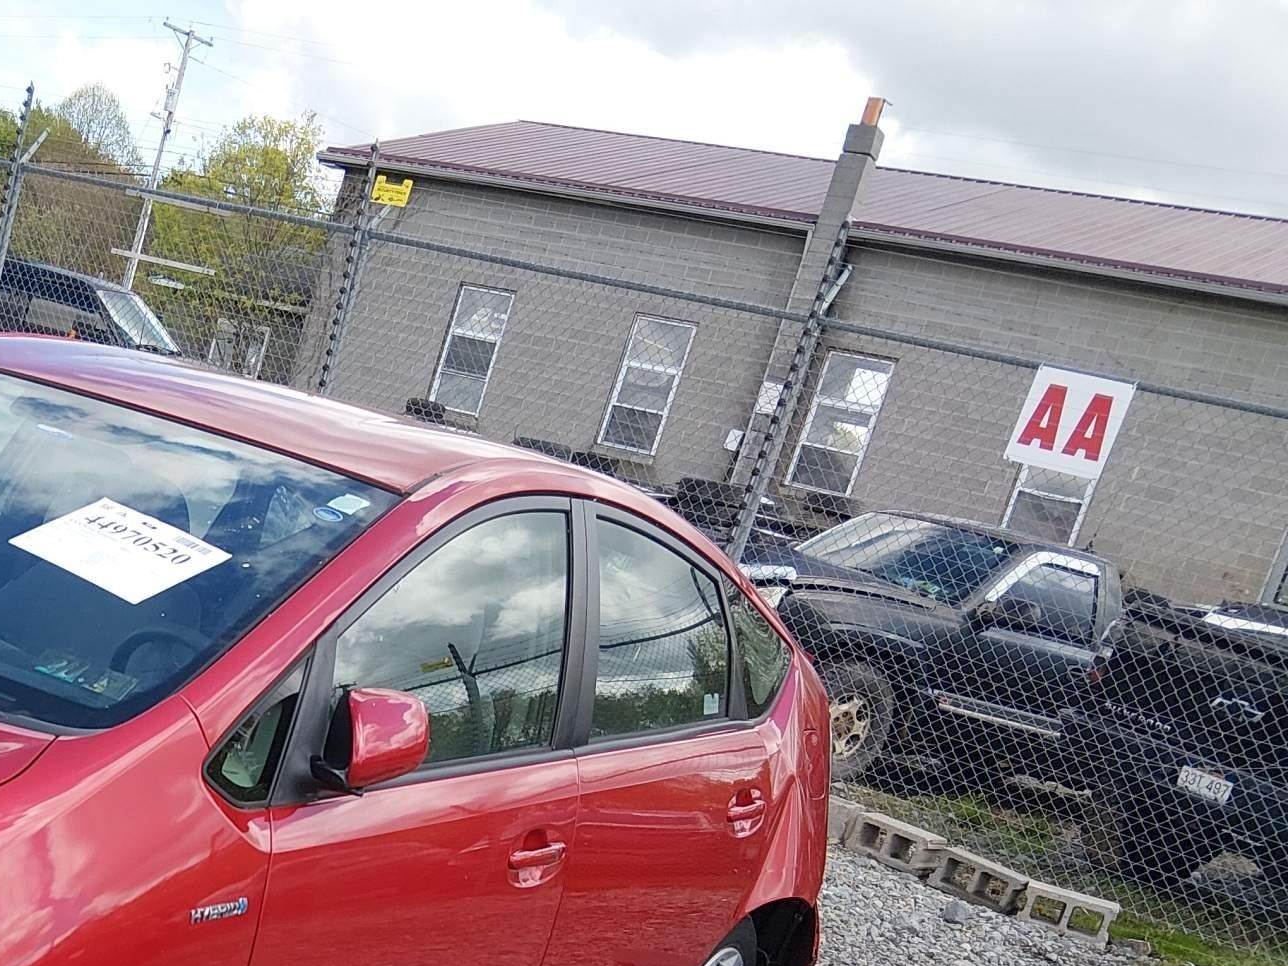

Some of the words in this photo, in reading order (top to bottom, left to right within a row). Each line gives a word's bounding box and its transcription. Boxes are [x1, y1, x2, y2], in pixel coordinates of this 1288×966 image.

[1016, 384, 1114, 462] AA
[84, 514, 191, 565] 44970520
[1206, 781, 1230, 799] 497
